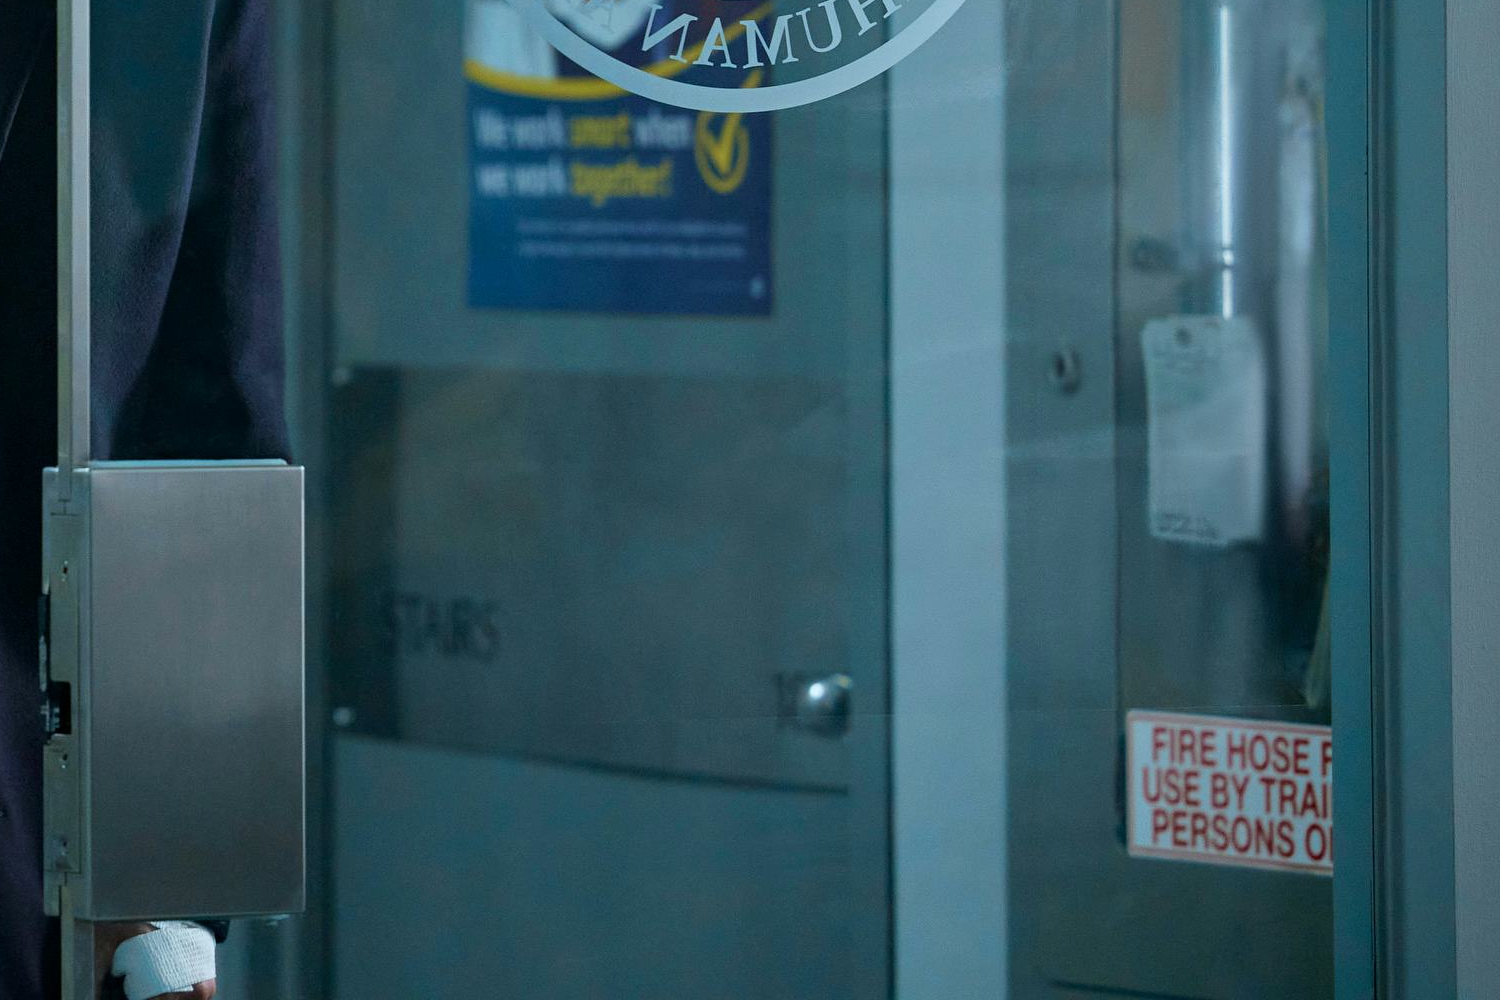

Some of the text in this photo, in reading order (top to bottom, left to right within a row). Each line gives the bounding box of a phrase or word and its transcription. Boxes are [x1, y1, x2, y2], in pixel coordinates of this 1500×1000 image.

[512, 105, 565, 149] work
[512, 155, 567, 196] work
[1152, 727, 1216, 767] FIRE
[1227, 734, 1310, 777] HOSE
[1142, 768, 1332, 820] USE BY TRAI
[1152, 808, 1332, 862] PERSONS O
